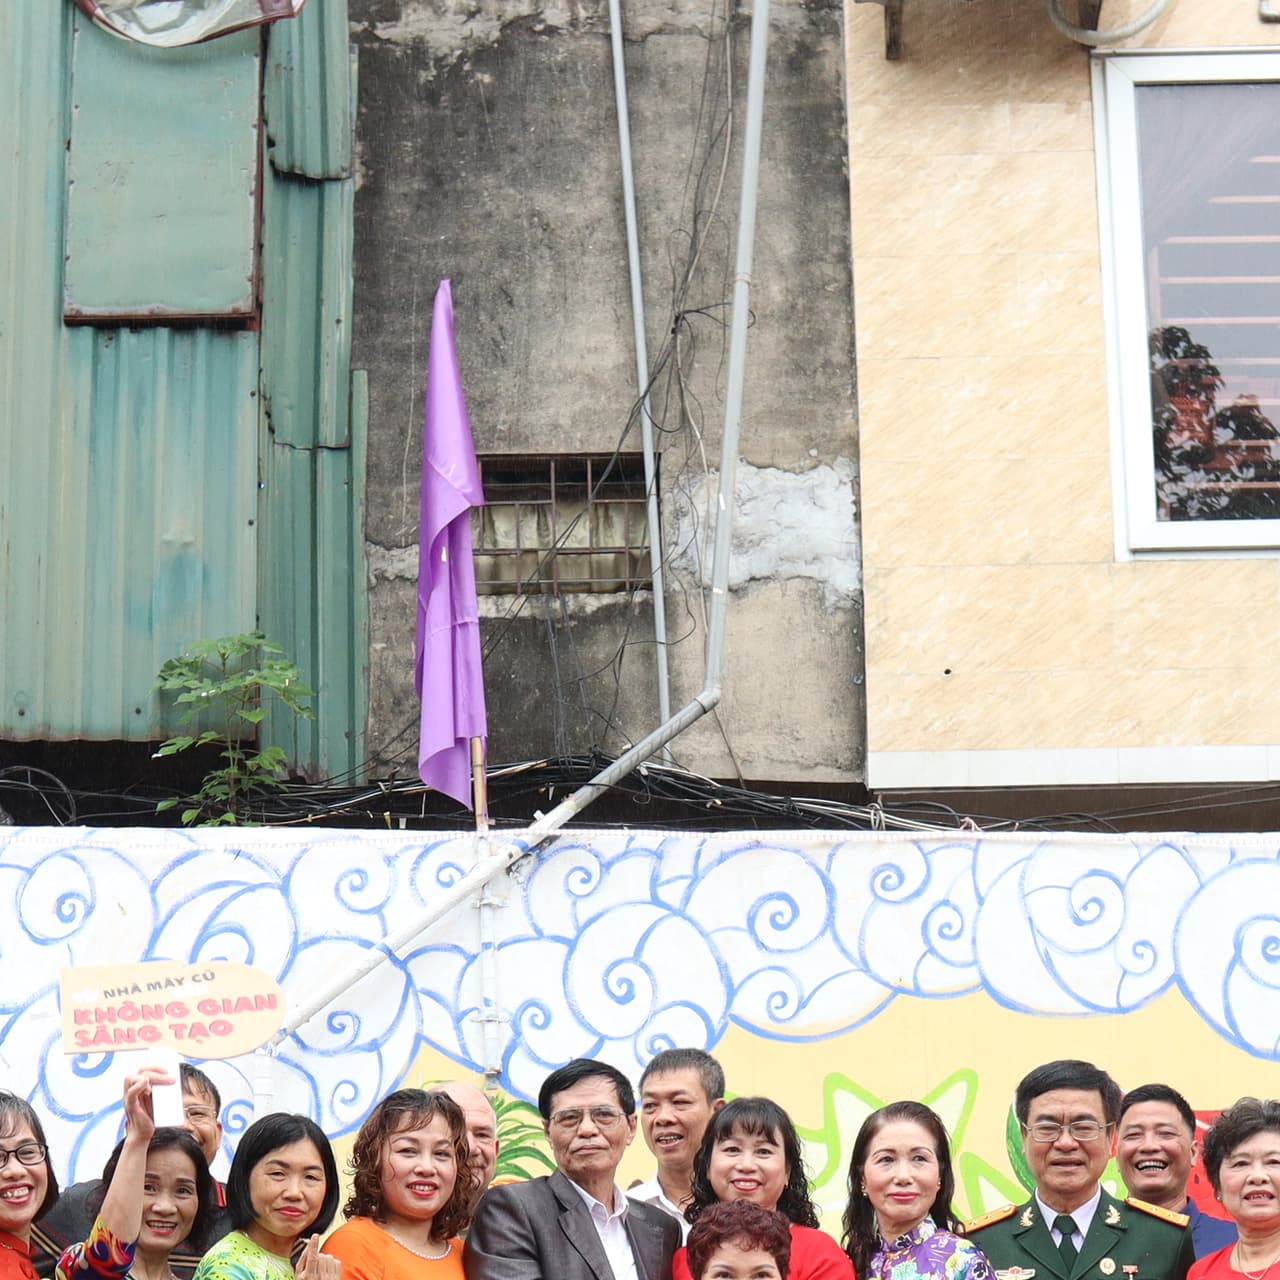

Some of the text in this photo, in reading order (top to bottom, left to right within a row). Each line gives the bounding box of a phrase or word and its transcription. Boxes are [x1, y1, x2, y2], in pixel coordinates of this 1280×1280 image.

[74, 994, 278, 1026] KHÔNG GIAN
[74, 1019, 234, 1047] SÁNG TẠO
